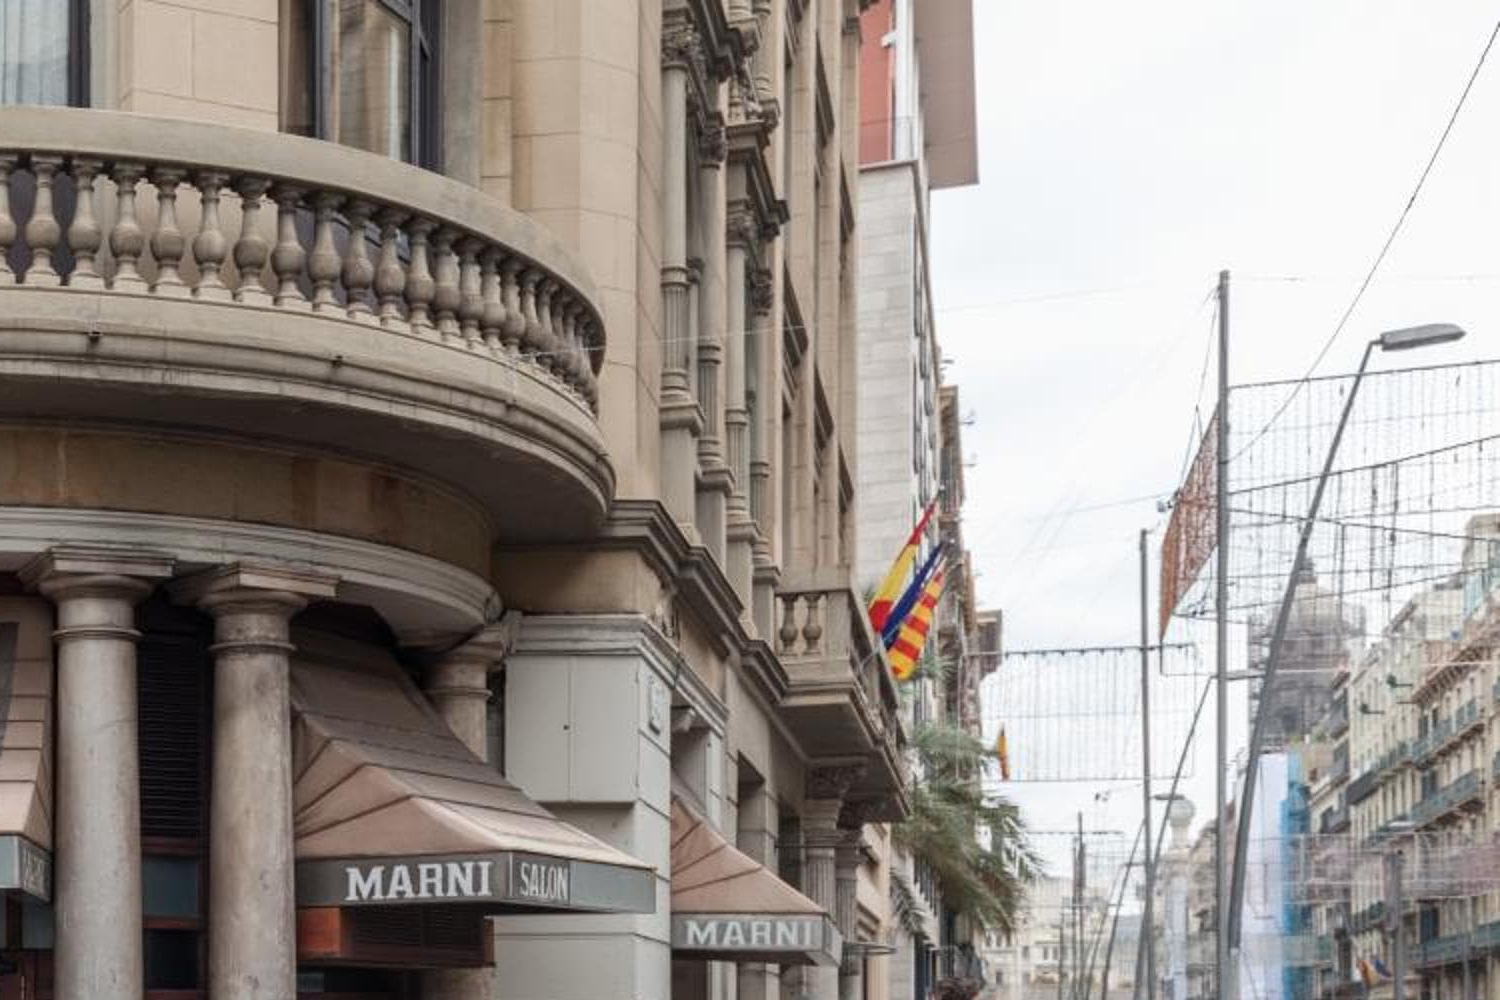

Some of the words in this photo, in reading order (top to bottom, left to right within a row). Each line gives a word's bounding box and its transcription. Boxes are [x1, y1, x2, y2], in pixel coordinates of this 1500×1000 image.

[345, 860, 493, 900] MARNI
[519, 863, 569, 900] SALON
[686, 920, 814, 946] MARNI
